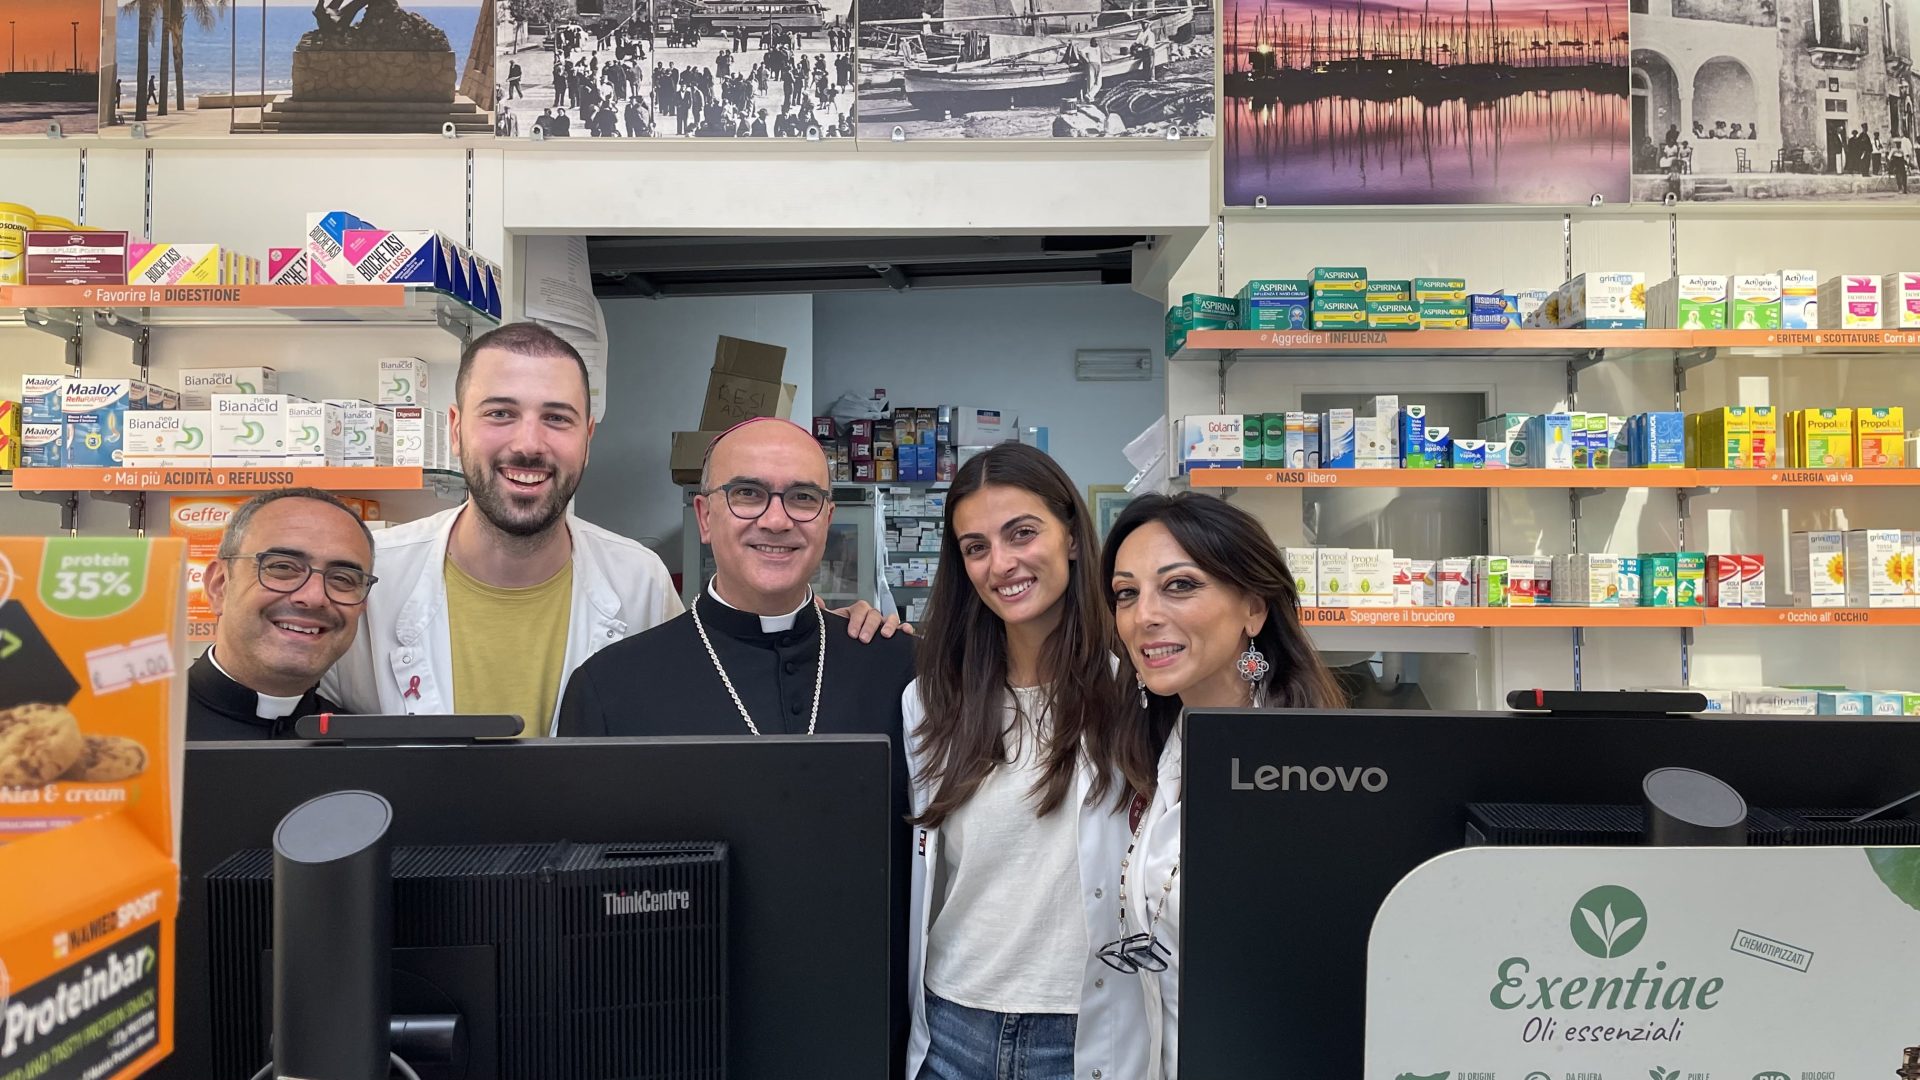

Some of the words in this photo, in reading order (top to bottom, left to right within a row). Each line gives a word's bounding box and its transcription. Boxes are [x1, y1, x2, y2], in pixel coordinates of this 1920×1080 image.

[309, 225, 343, 260] BIOCHETASI
[356, 232, 406, 282] BIOCHETASI
[145, 247, 181, 284] BIOCHETASI
[378, 247, 412, 282] REFLUSSO
[1259, 283, 1298, 291] ASPIRINA
[96, 289, 146, 302] Favorire
[150, 289, 161, 302] la
[164, 289, 240, 302] DIGESTIONE
[1200, 300, 1236, 313] ASPIRINA
[1377, 304, 1413, 312] ASPIRINA
[1272, 333, 1322, 346] Aggredire
[1325, 332, 1388, 343] l'INFLUENZA
[1776, 333, 1814, 343] ERITEMI
[1816, 335, 1822, 343] e
[1884, 333, 1905, 343] Corri
[381, 361, 413, 369] Bianacid
[25, 378, 59, 387] Maalox
[184, 375, 233, 386] Bianacid
[66, 383, 121, 397] Maalox
[219, 400, 278, 412] Bianacid
[289, 408, 322, 416] Bianacid
[129, 418, 179, 429] Bianacid
[1208, 418, 1241, 432] Golamir
[25, 427, 60, 437] Maalox
[115, 472, 139, 485] Mai
[141, 472, 160, 488] più
[164, 468, 214, 485] ACIDITÀ
[217, 475, 225, 485] o
[229, 471, 294, 485] REFLUSSO
[1276, 472, 1305, 483] NASO
[1307, 472, 1337, 483] libero
[1781, 473, 1824, 482] ALLERGIA
[1826, 473, 1839, 482] vai
[1840, 473, 1854, 482] via
[178, 506, 230, 522] Geffer
[61, 553, 130, 570] protein
[1288, 552, 1314, 561] Propol
[1320, 552, 1348, 561] Propol
[1351, 554, 1379, 563] Propol
[52, 571, 132, 600] 35%
[1304, 610, 1314, 621] DI
[1351, 610, 1400, 624] Spegnere
[1403, 610, 1409, 621] il
[1411, 610, 1455, 621] bruciore
[1787, 612, 1818, 622] Occhio
[1834, 612, 1869, 622] OCCHIO
[1231, 757, 1388, 793] Lenovo
[65, 786, 125, 803] cream
[603, 889, 690, 916] ThinkCentre
[1738, 935, 1806, 967] CHEMOTIPIZZATI
[1489, 956, 1725, 1011] Exentiae
[1, 945, 147, 1058] Proteinbar
[1522, 1016, 1556, 1042] Oli
[1564, 1020, 1685, 1042] essenziali
